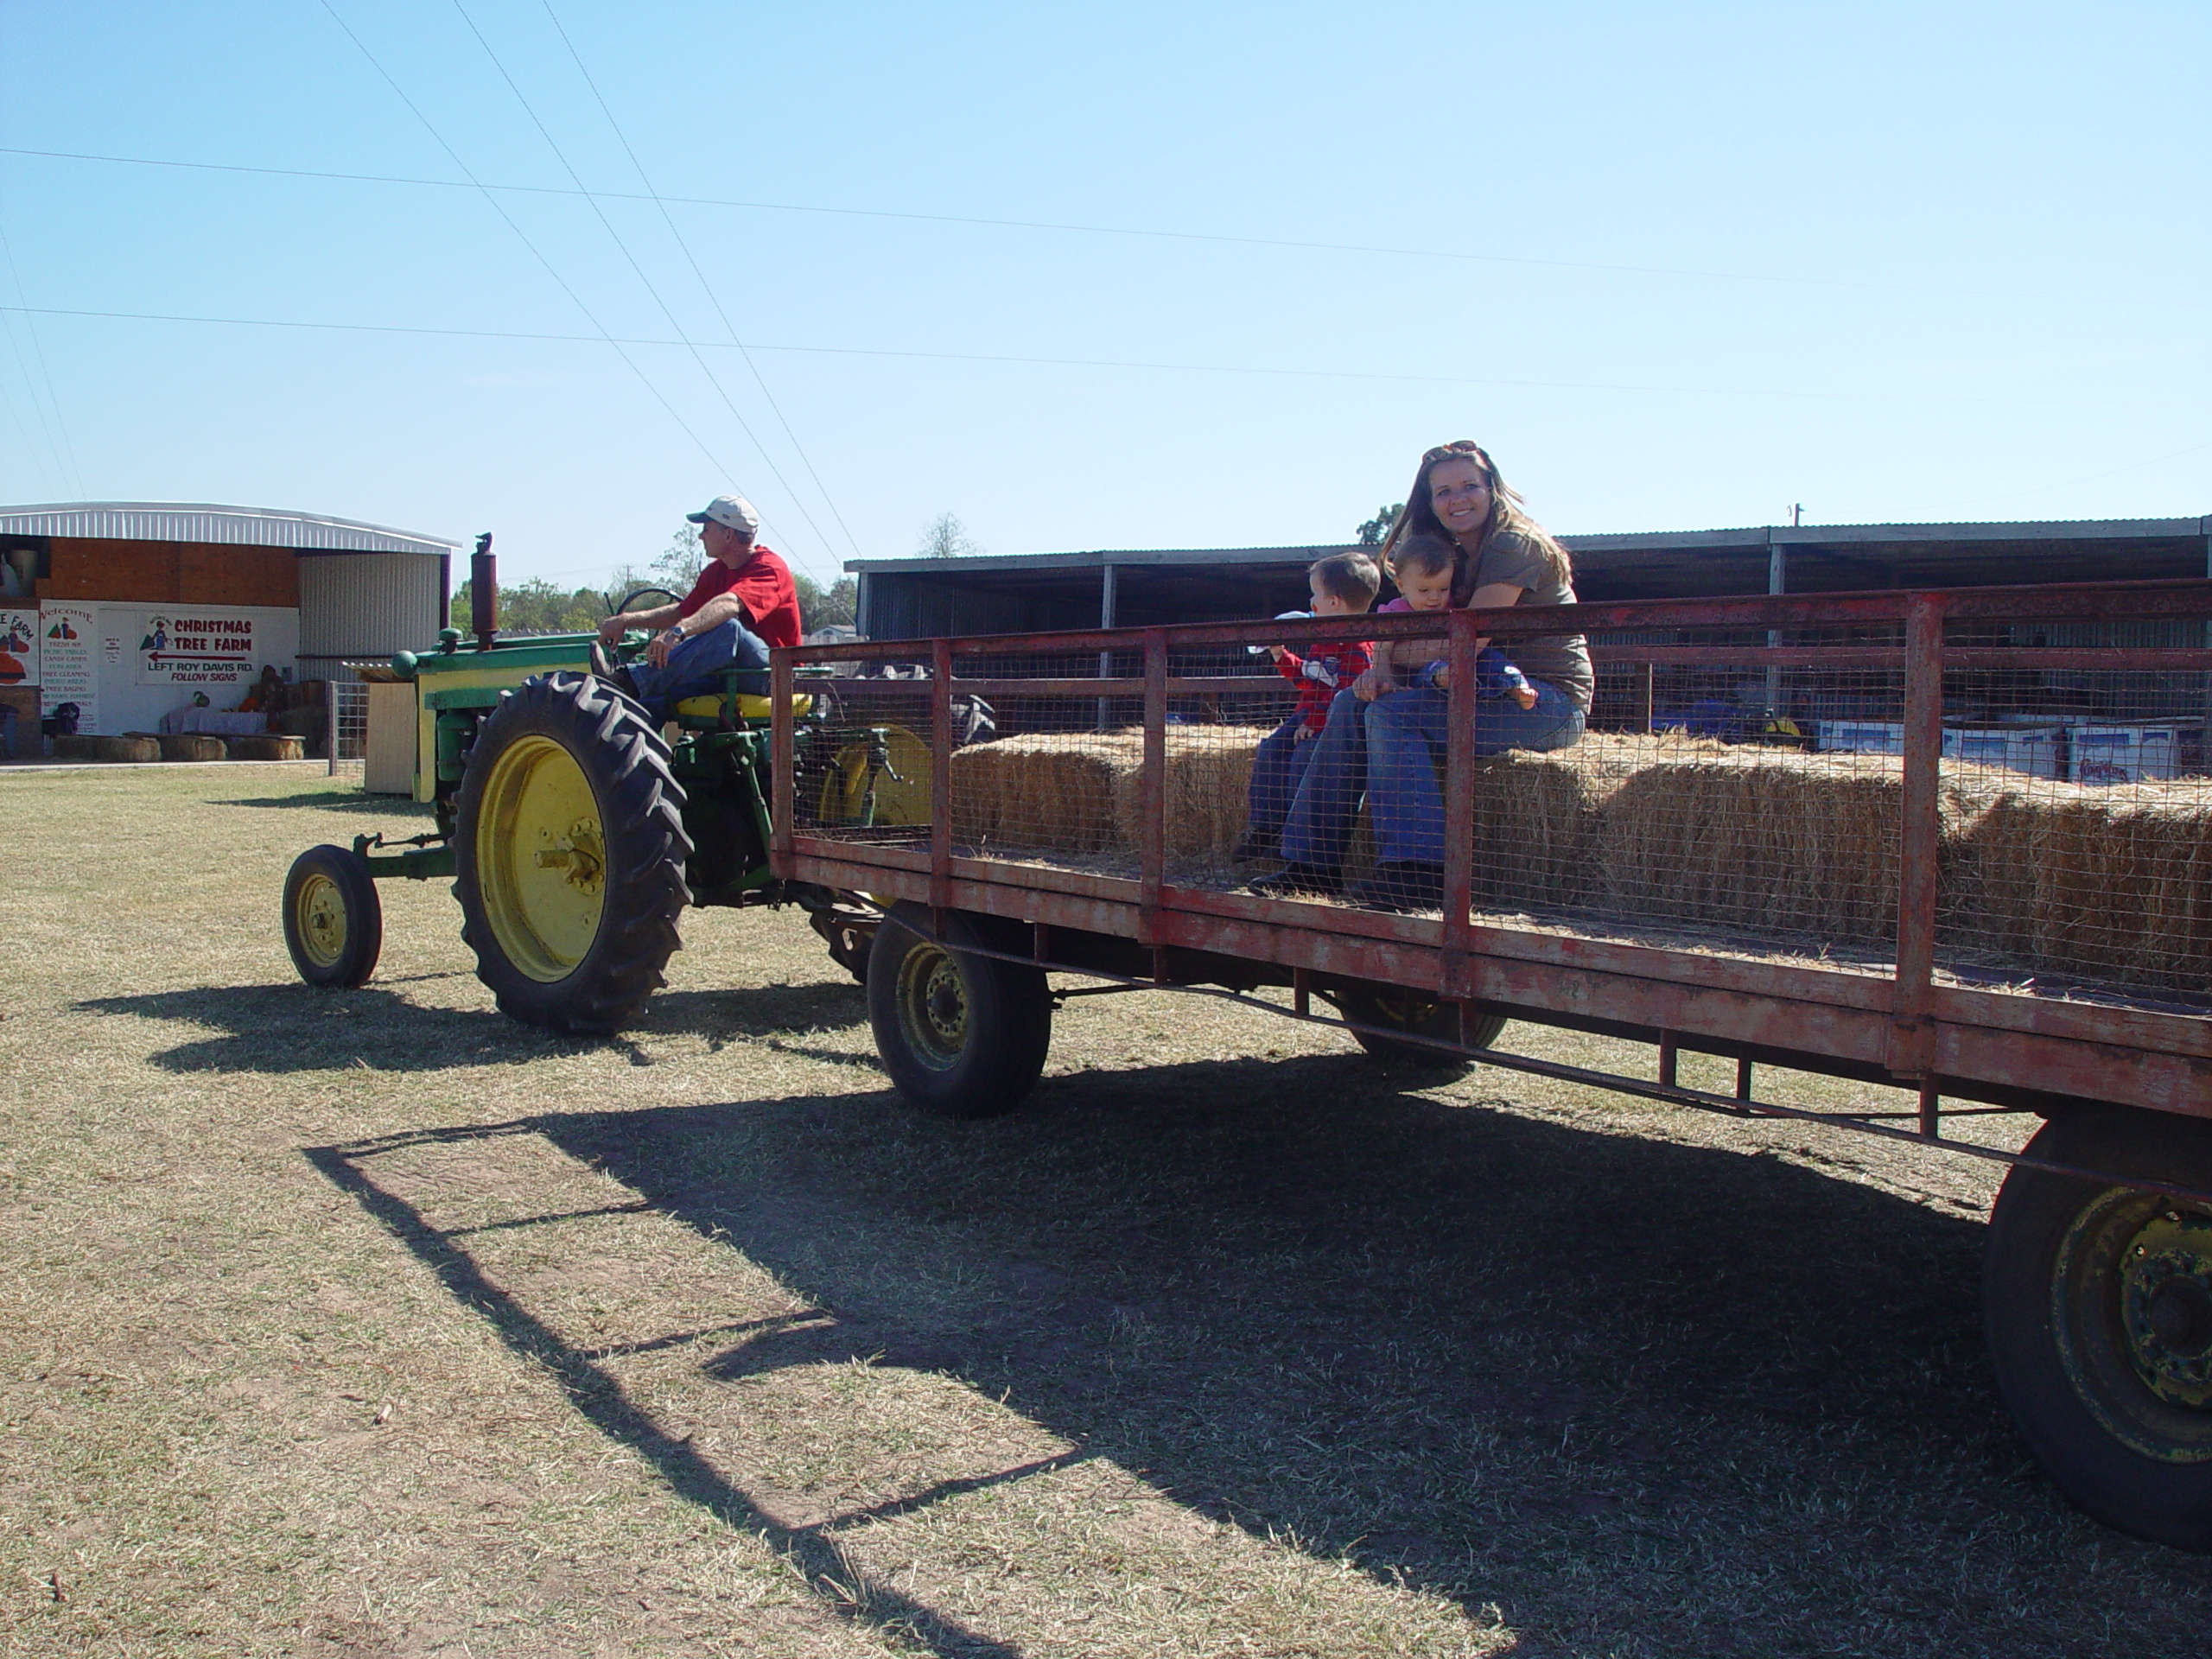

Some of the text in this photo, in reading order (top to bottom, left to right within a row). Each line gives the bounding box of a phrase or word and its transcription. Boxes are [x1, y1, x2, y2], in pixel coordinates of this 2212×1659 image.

[11, 615, 34, 640] FARM
[175, 619, 251, 633] CHRISTMAS
[175, 637, 251, 651] TREE FARM
[148, 662, 174, 671] LEFT
[177, 663, 200, 671] ROY
[202, 663, 234, 671] DAVIS
[171, 672, 238, 682] FOLLOW SIGNS
